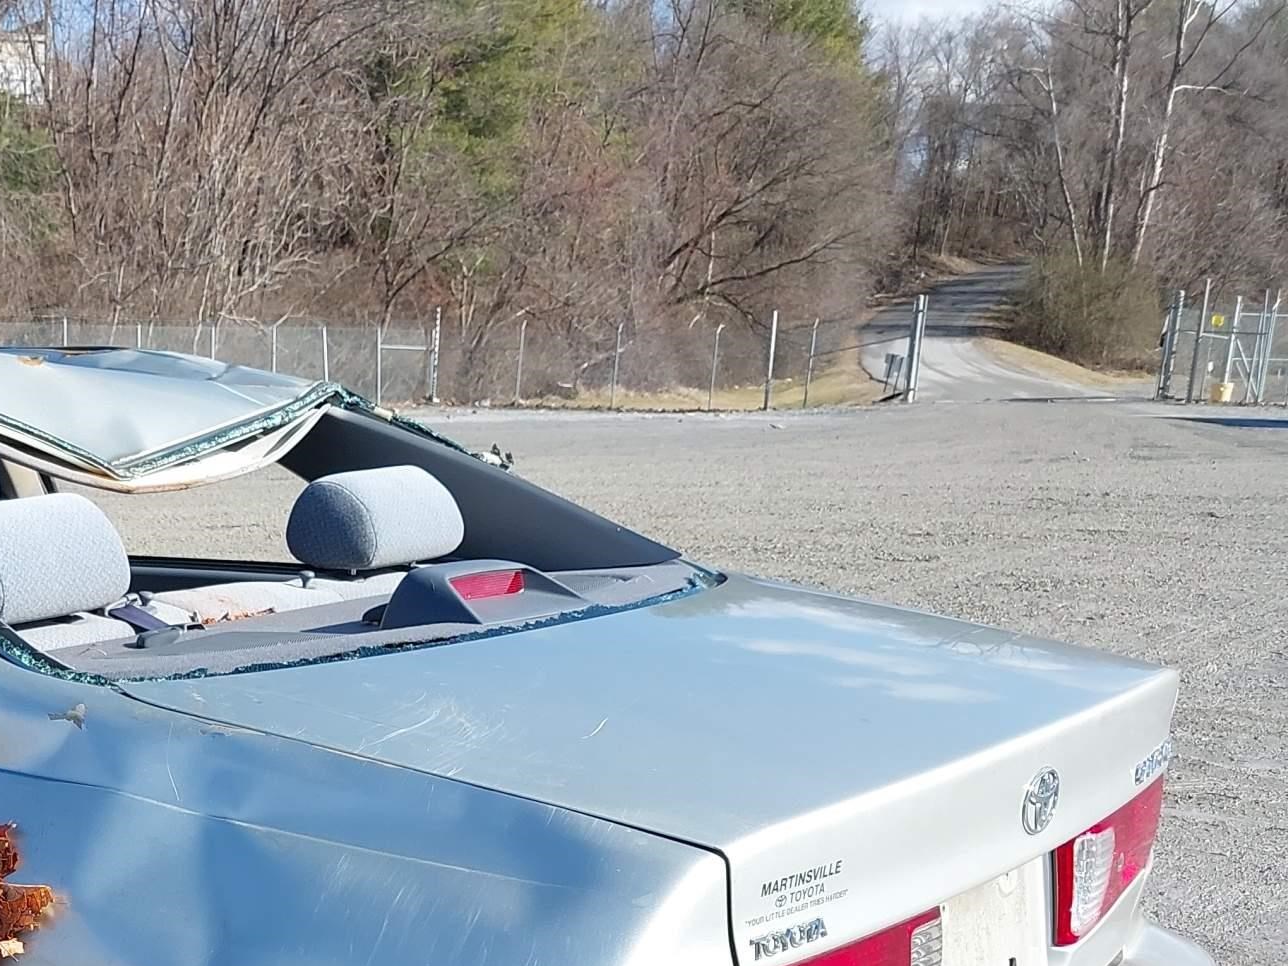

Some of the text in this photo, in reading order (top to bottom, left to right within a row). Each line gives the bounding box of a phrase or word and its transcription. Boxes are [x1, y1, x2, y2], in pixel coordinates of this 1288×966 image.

[760, 860, 842, 897] MARTINSVILLE
[790, 883, 825, 903] TOYOTA
[765, 910, 786, 922] LITTLE
[749, 918, 828, 960] TOYOTA
